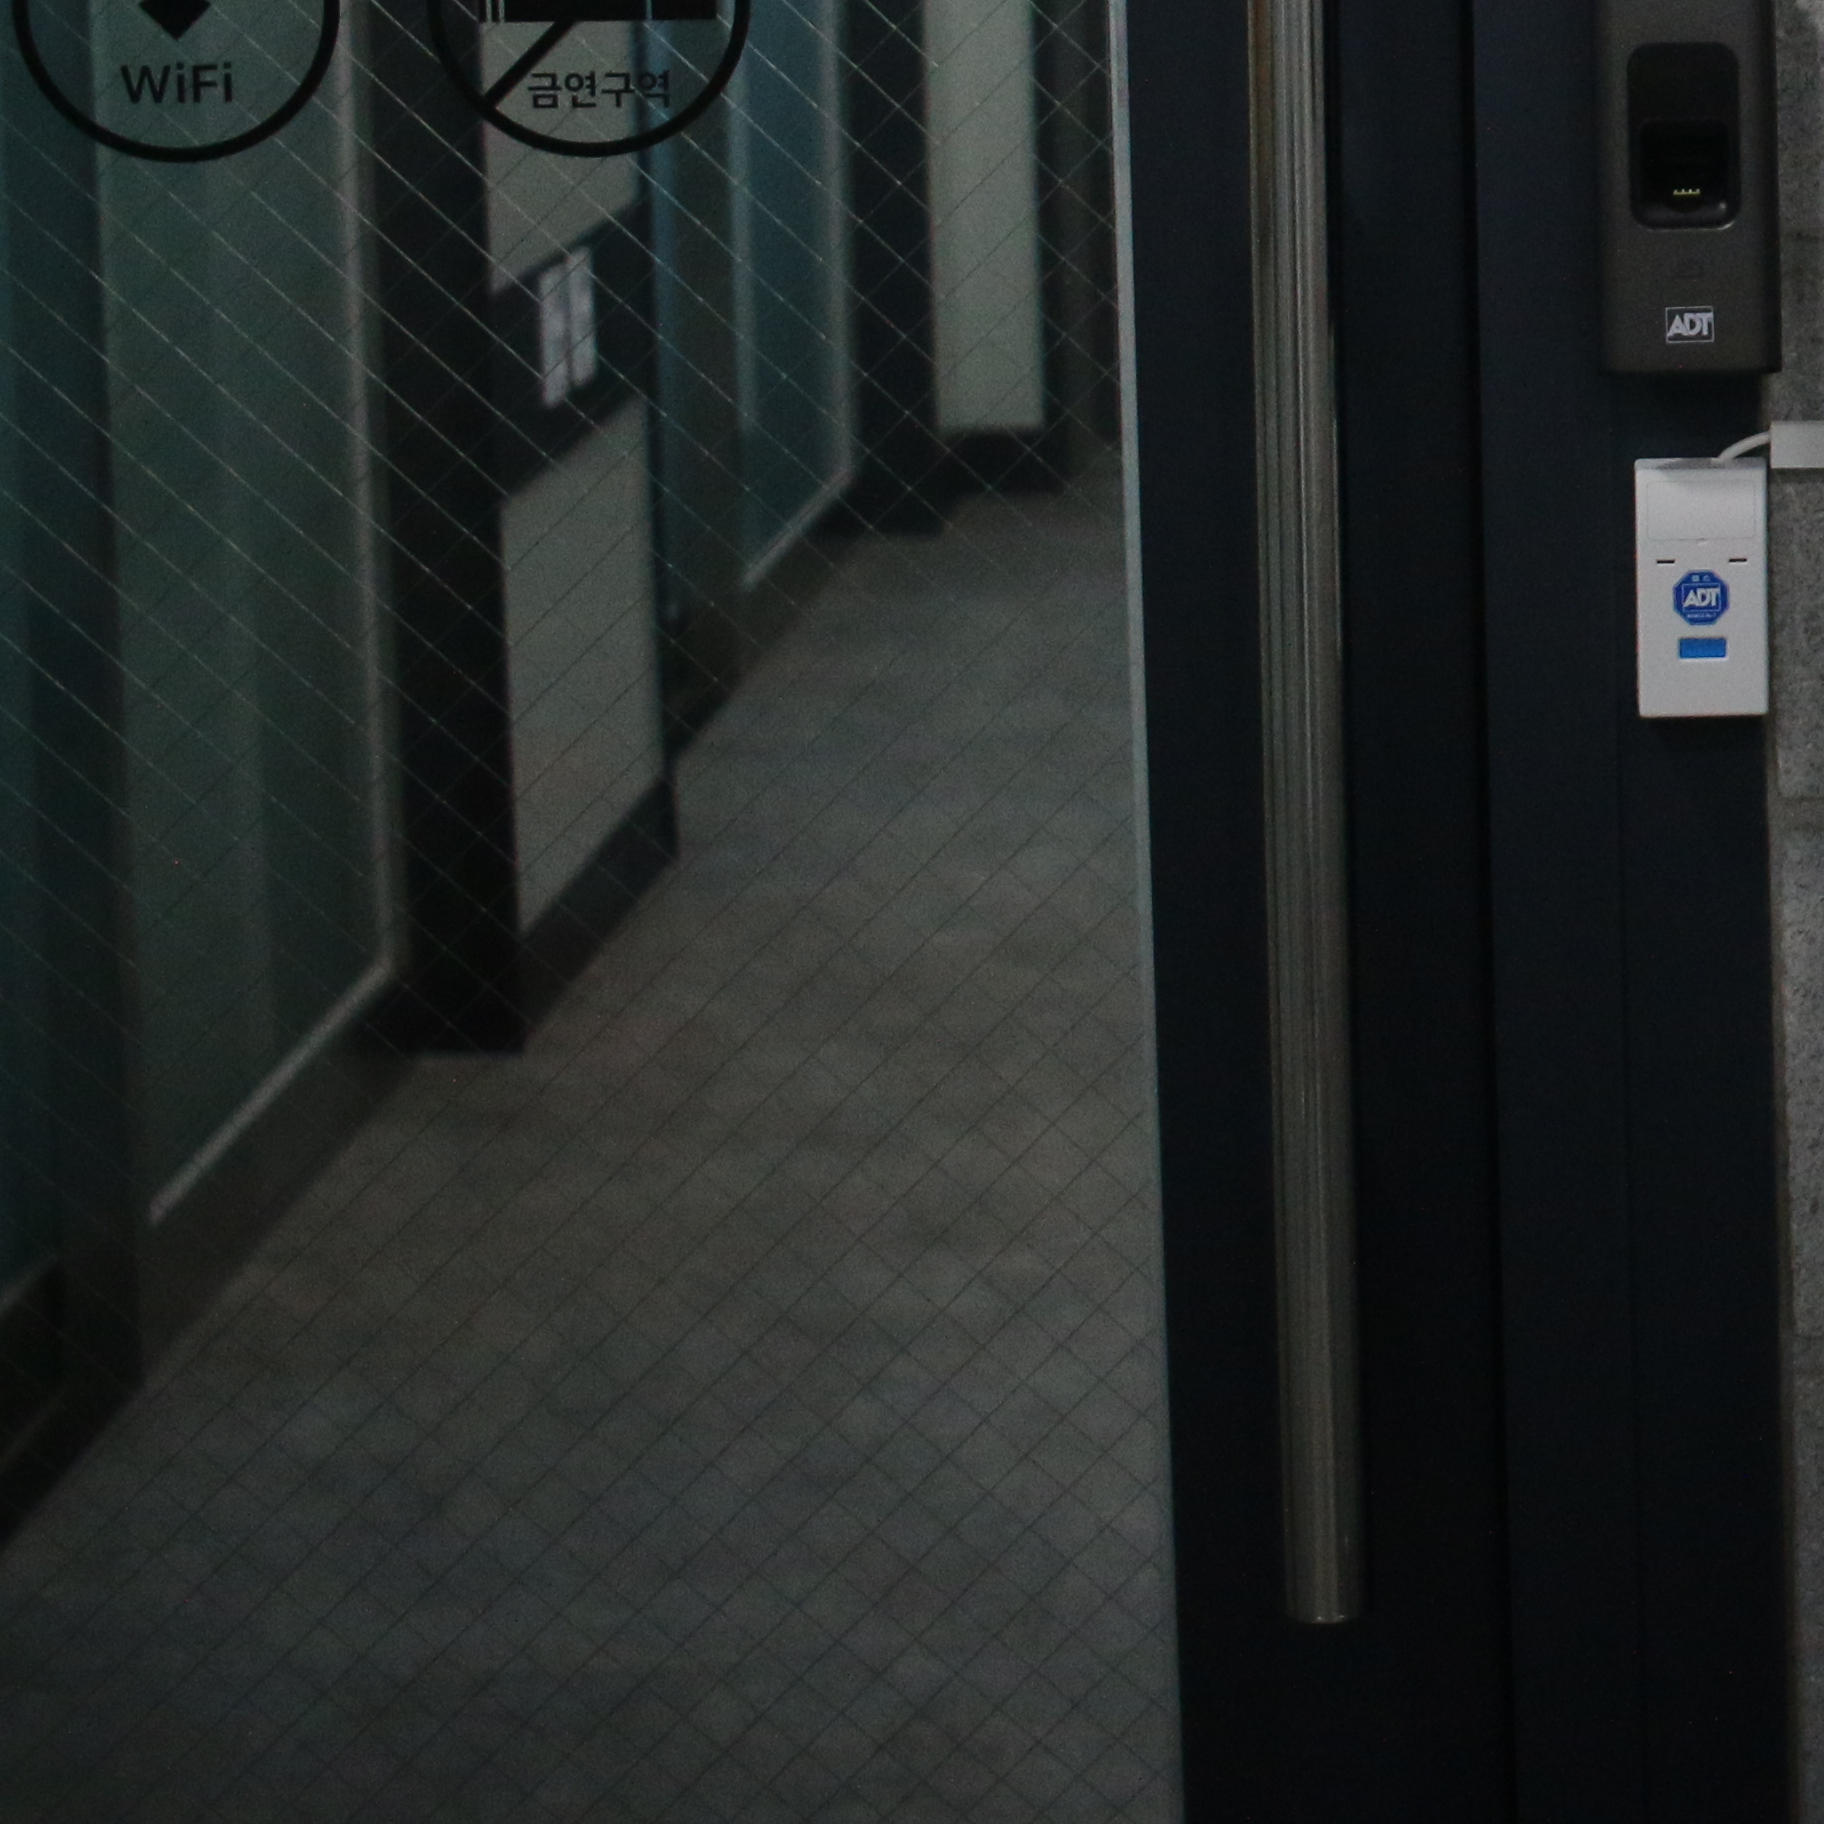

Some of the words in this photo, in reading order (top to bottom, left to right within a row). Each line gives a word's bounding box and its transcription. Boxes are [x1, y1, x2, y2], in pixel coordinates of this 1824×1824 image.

[121, 62, 234, 104] WiFi
[527, 68, 673, 110] 금연구역
[1667, 312, 1714, 336] ADT
[1683, 587, 1721, 608] ADT
